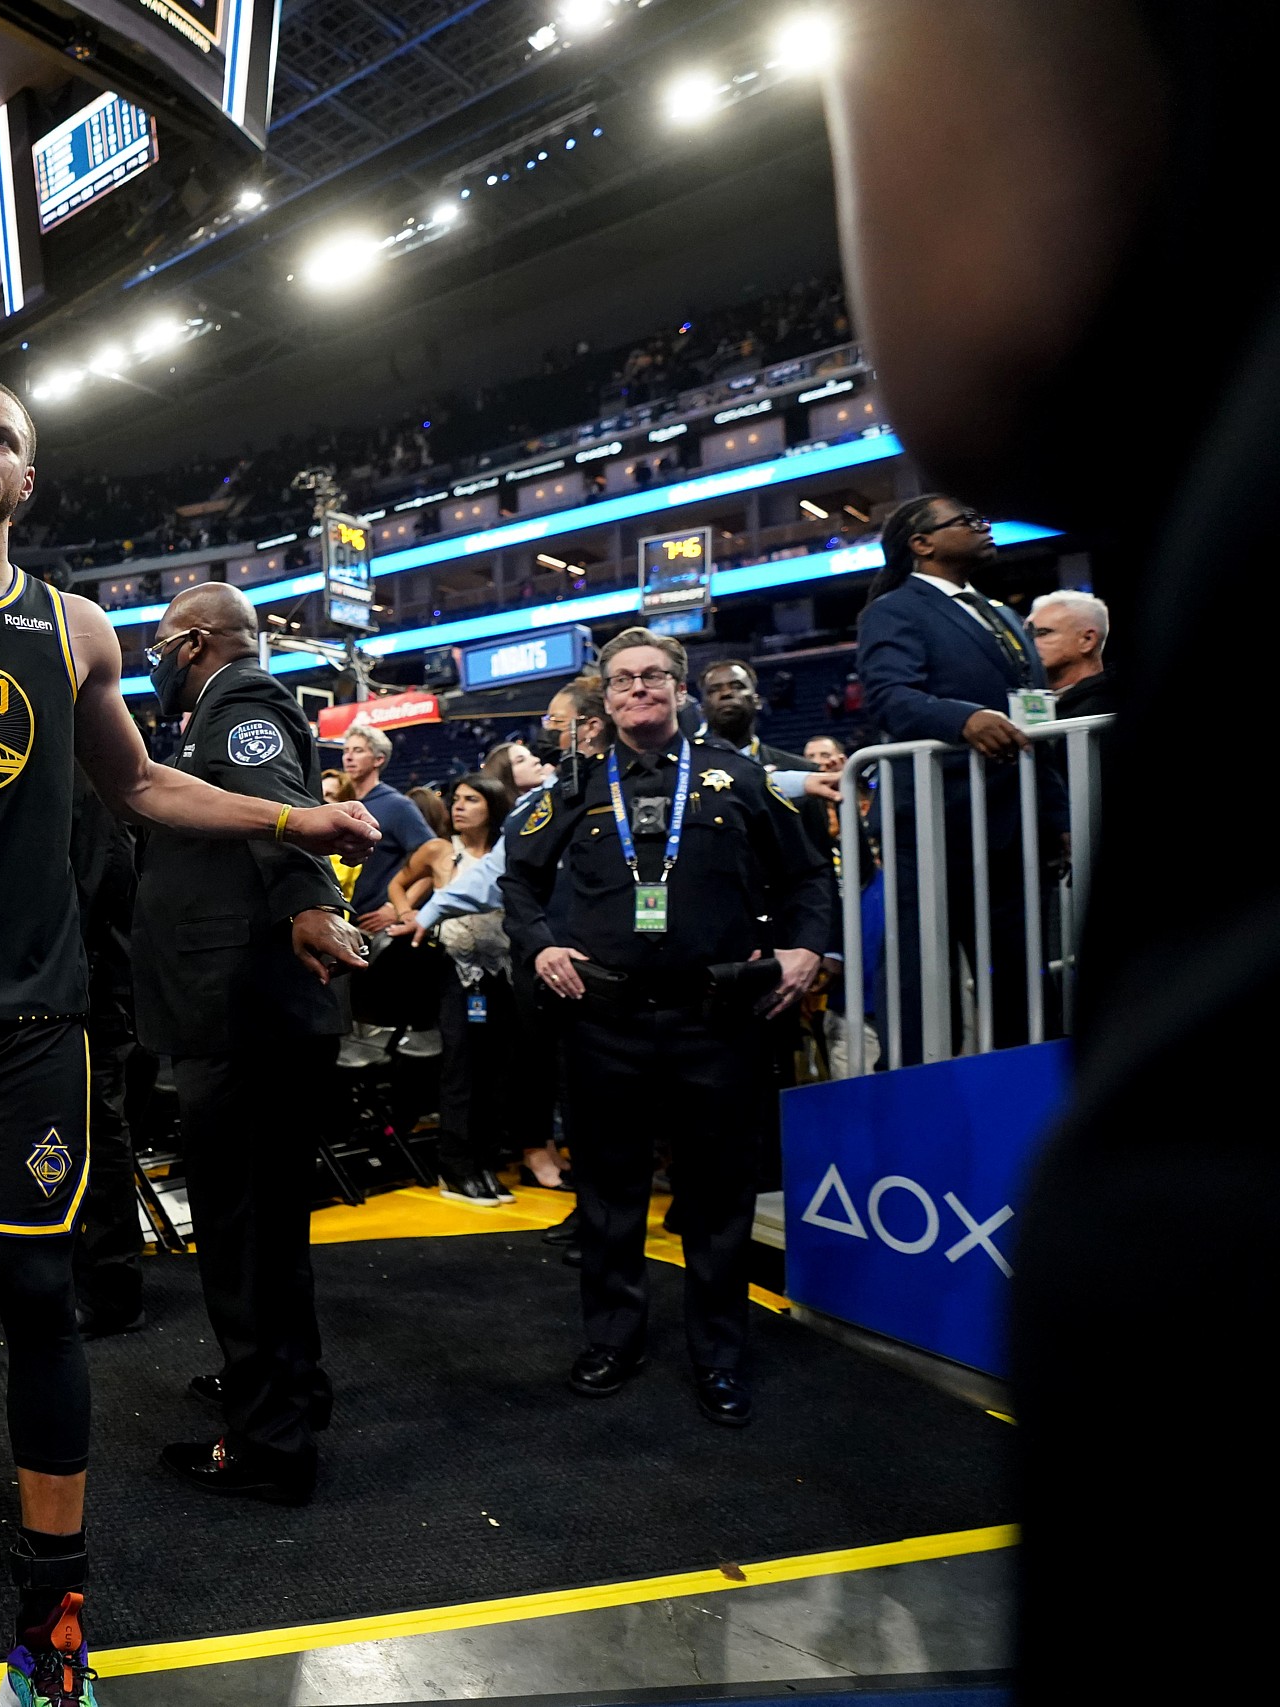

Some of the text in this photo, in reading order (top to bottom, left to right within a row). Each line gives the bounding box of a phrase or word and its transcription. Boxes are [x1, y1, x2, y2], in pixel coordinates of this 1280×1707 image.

[4, 613, 53, 631] Rakuten
[238, 723, 263, 734] ALLIED
[238, 729, 277, 740] UNIVERSAL
[33, 1144, 68, 1183] 75
